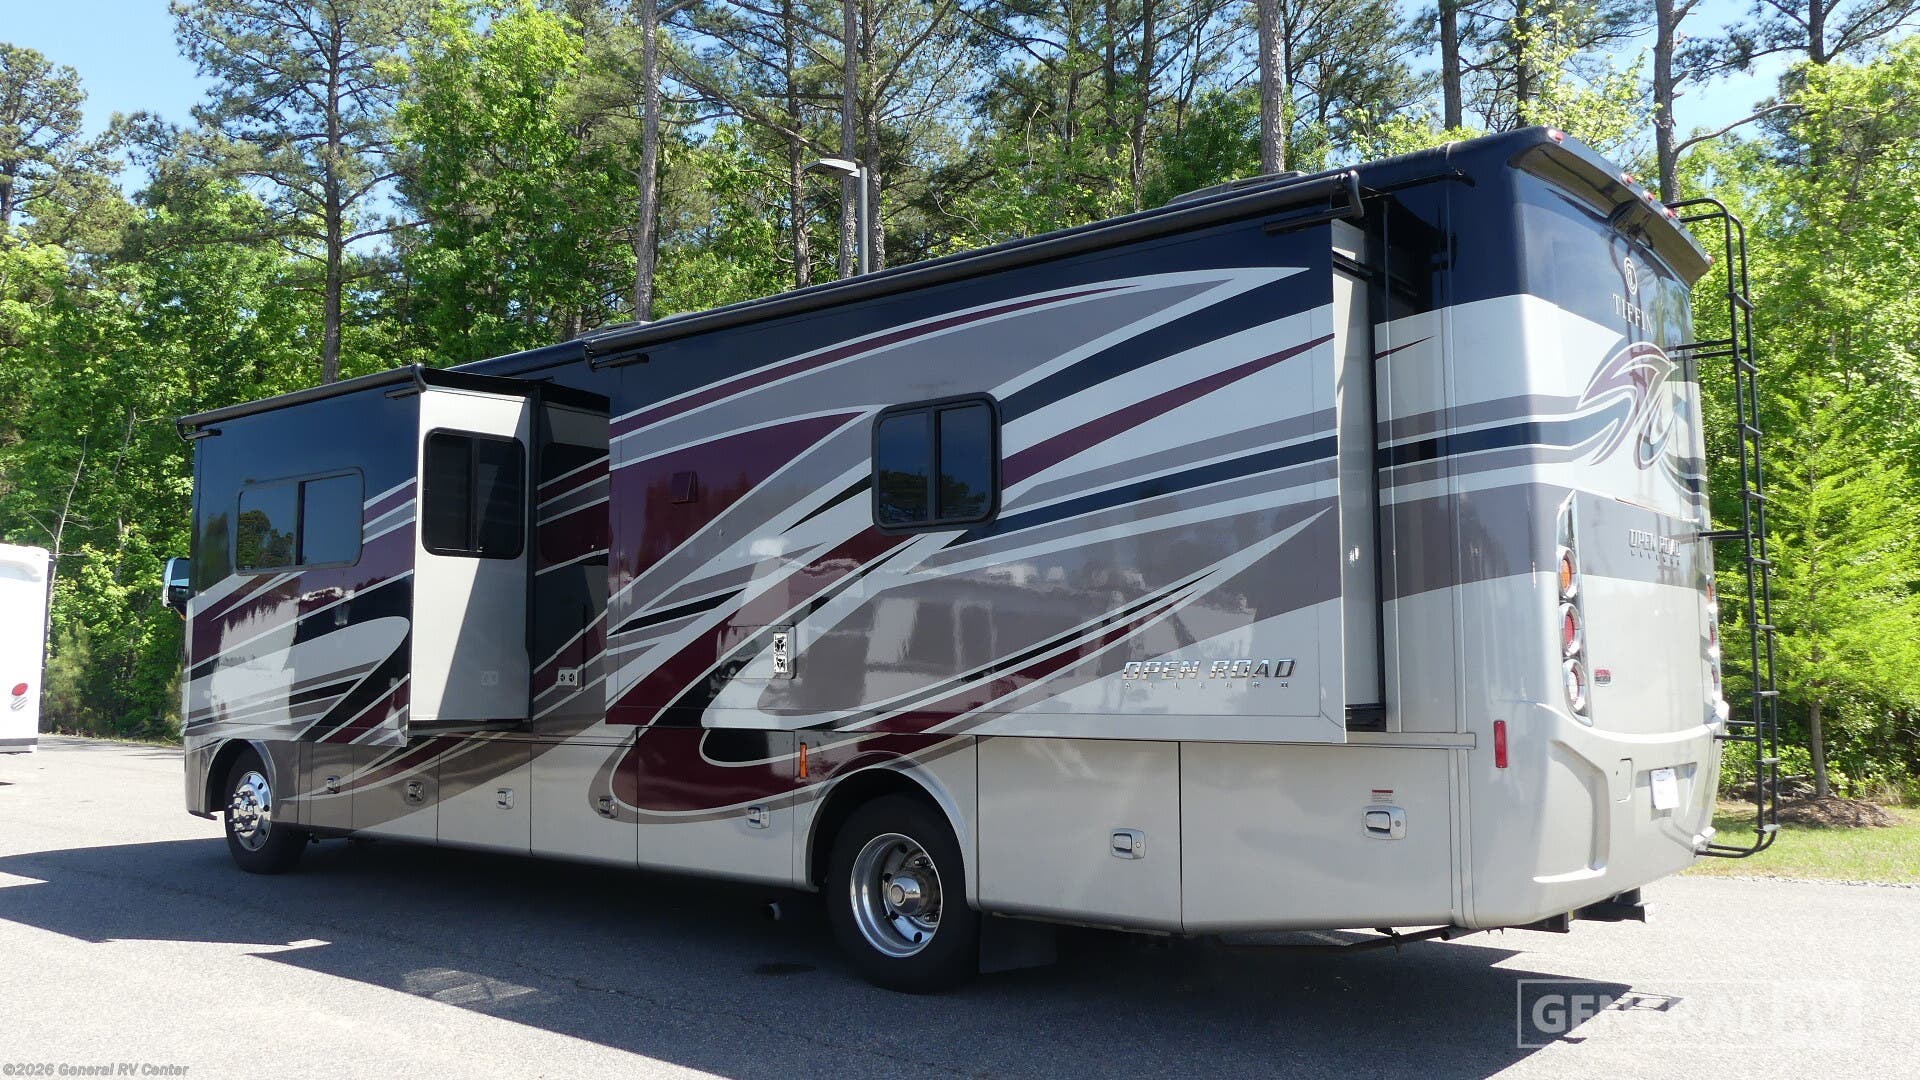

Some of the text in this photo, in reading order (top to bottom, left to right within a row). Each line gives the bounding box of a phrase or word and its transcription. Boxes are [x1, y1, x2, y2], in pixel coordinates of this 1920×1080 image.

[1613, 293, 1655, 336] TIFFIN
[1122, 659, 1296, 680] OPEN ROAD
